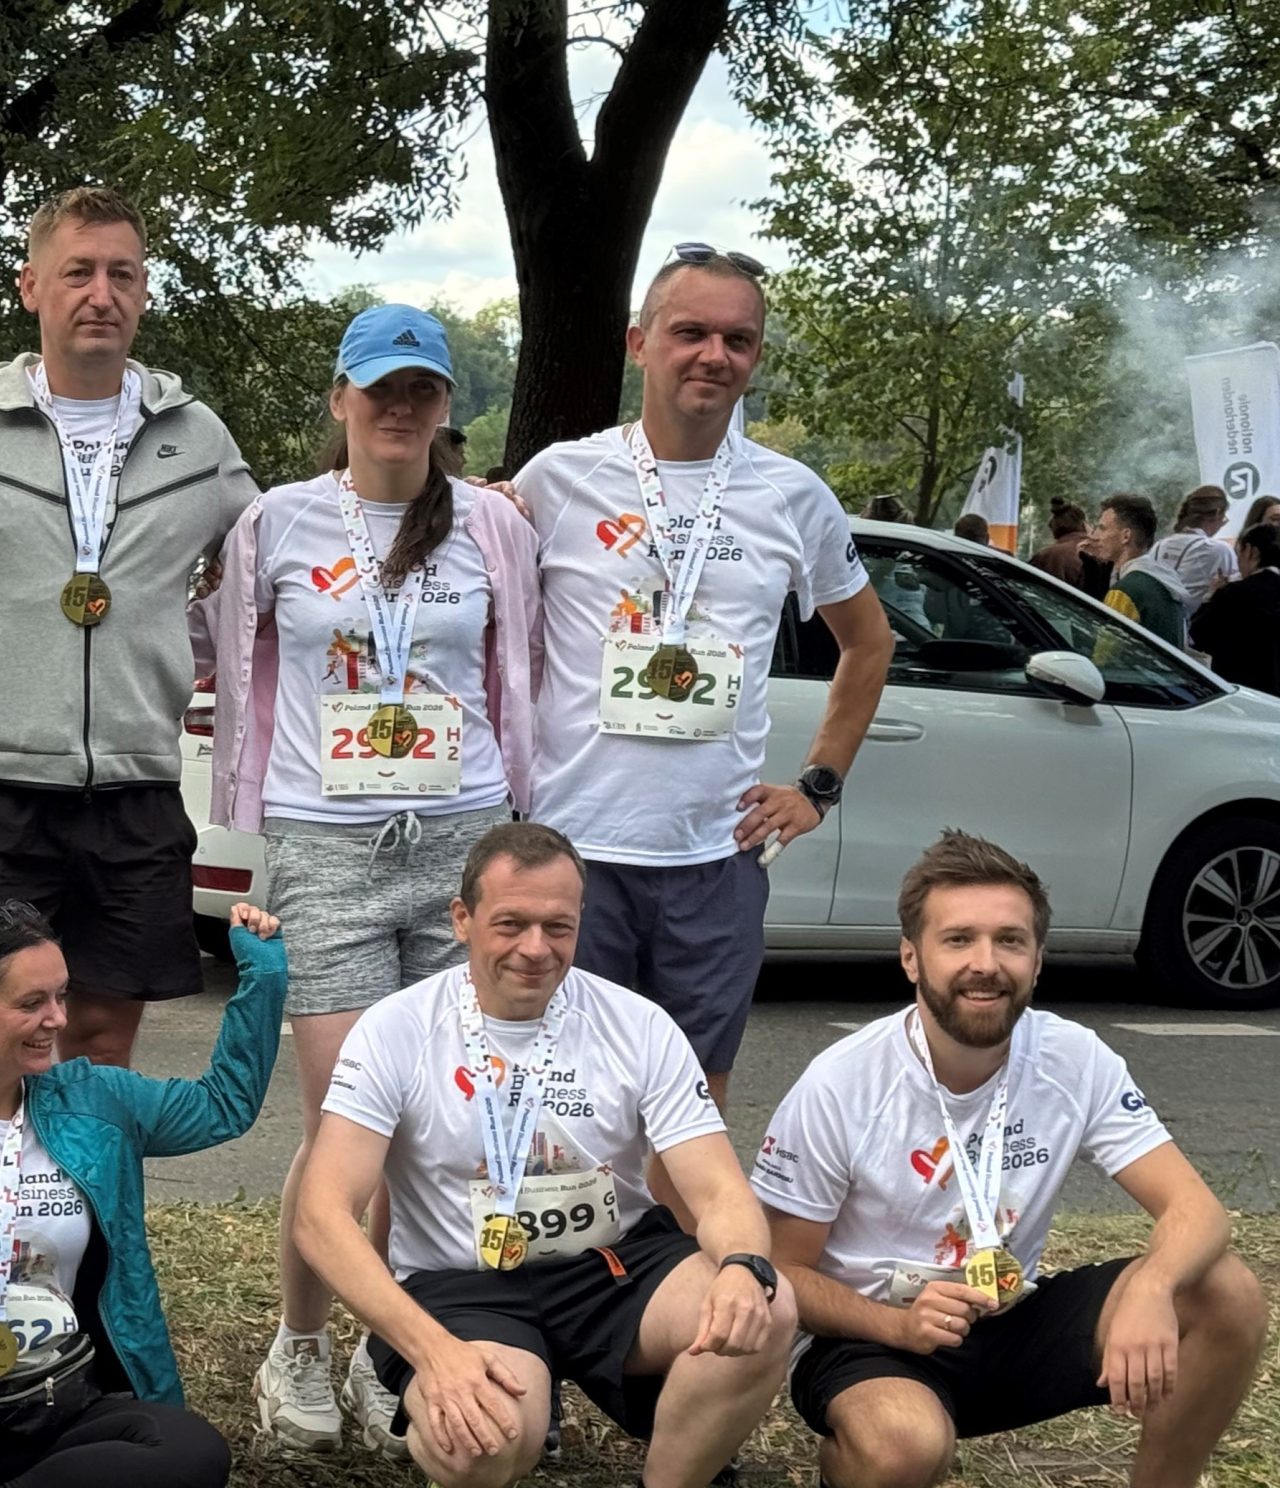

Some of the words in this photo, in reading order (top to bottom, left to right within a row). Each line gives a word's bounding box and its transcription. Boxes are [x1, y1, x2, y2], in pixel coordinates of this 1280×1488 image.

[706, 547, 743, 561] 026
[421, 591, 461, 604] 026
[610, 666, 716, 706] 292
[727, 674, 741, 690] H
[725, 694, 737, 708] 5
[368, 719, 392, 739] 15
[446, 727, 460, 742] H
[331, 727, 436, 759] 292
[448, 746, 459, 761] 2
[510, 1075, 587, 1099] Bness
[775, 1146, 799, 1163] HSBC
[1001, 1148, 1049, 1171] 2026
[21, 1186, 75, 1200] siness
[603, 1191, 615, 1206] G
[37, 1200, 83, 1216] 2026
[607, 1209, 615, 1222] 1
[484, 1203, 595, 1242] 899
[480, 1228, 503, 1250] 15
[968, 1263, 994, 1288] 15
[63, 1315, 77, 1332] H
